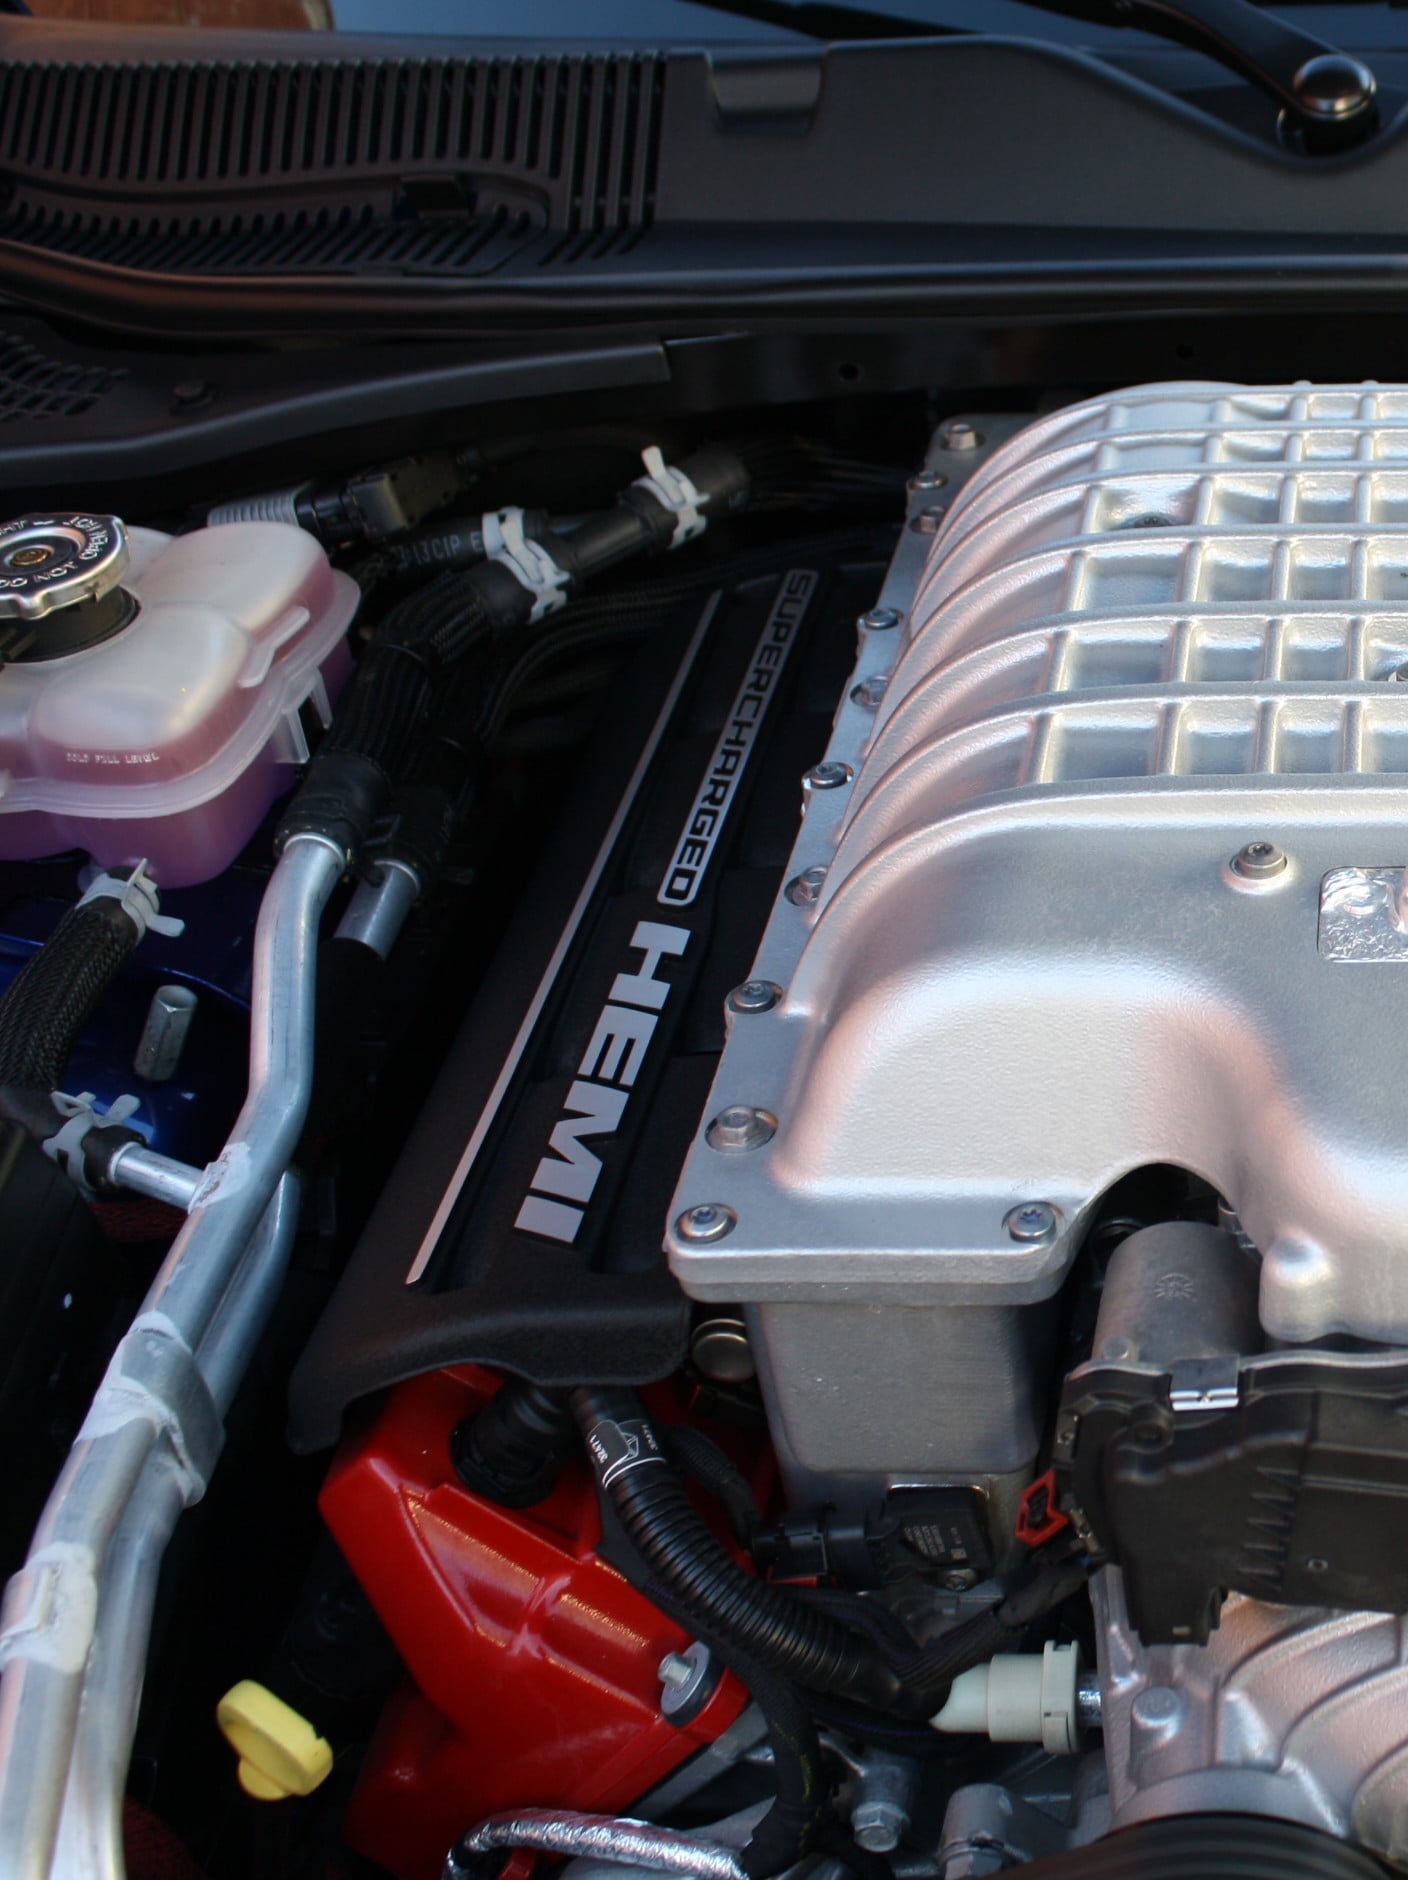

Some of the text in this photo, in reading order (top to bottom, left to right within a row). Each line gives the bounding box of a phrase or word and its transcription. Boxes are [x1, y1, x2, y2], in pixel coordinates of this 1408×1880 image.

[33, 561, 78, 583] NOT
[513, 573, 812, 1243] SUPERCHARGED HEMI
